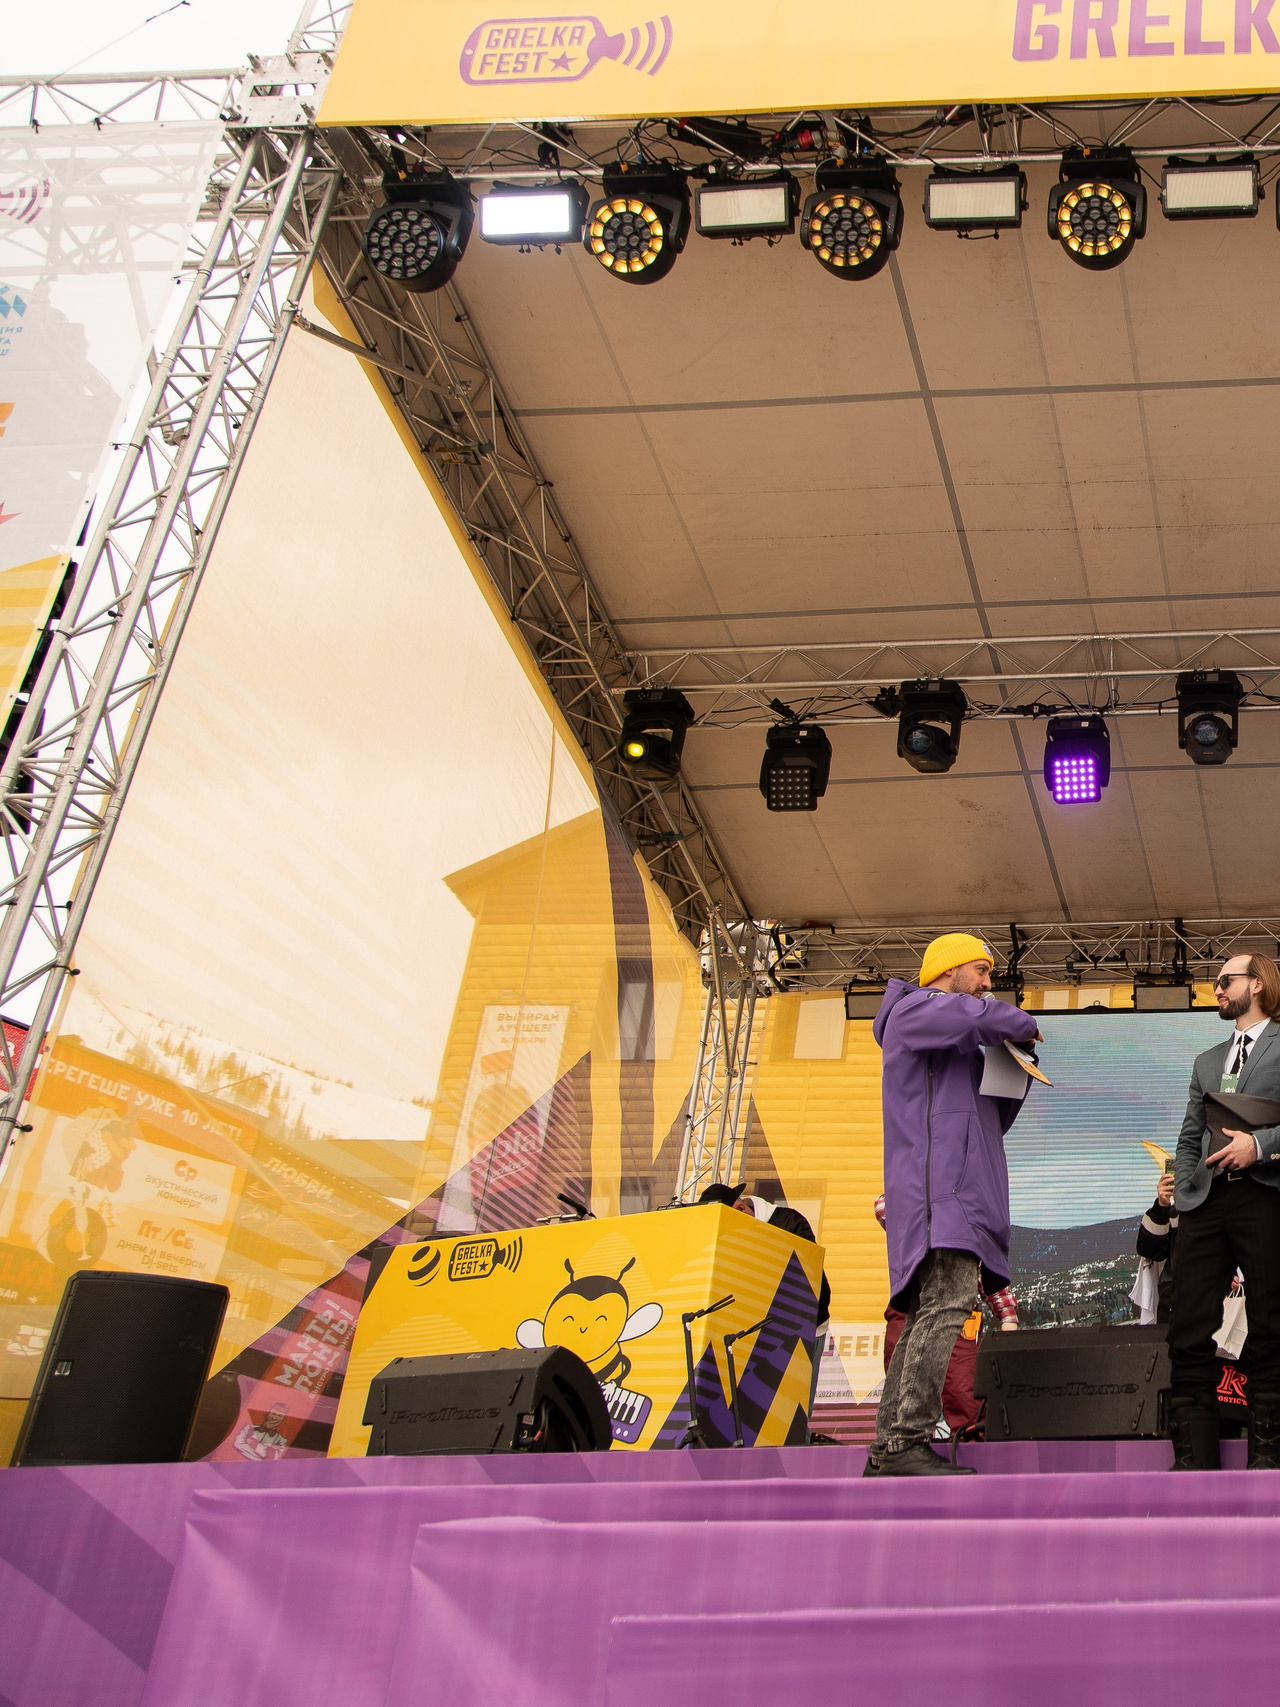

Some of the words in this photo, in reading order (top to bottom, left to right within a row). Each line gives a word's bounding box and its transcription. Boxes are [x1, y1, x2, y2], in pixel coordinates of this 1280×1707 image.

[485, 25, 587, 49] GRELKA
[478, 51, 549, 75] FEST
[35, 1053, 131, 1102] ЕРЕГЕШЕ
[136, 1090, 176, 1118] УЖЕ
[182, 1109, 198, 1126] 10
[202, 1117, 242, 1141] ЛЕТ!
[145, 1174, 218, 1204] акустический
[262, 1156, 335, 1200] ЛЮБВИ
[157, 1189, 201, 1209] концерт
[116, 1239, 148, 1253] днем
[148, 1248, 157, 1256] и
[160, 1250, 207, 1270] вечером
[141, 1254, 178, 1274] Dj-sets
[457, 1244, 492, 1261] GRELKA
[0, 1252, 56, 1293] LKA
[454, 1260, 479, 1276] FEST
[274, 1299, 341, 1386] МАНТЫ
[293, 1308, 354, 1393] ПОНТЫ
[822, 1335, 880, 1356] ЕЕ!
[1007, 1381, 1140, 1398] ProTone
[1217, 1395, 1248, 1406] OSTIC'S
[388, 1407, 501, 1424] ProTone
